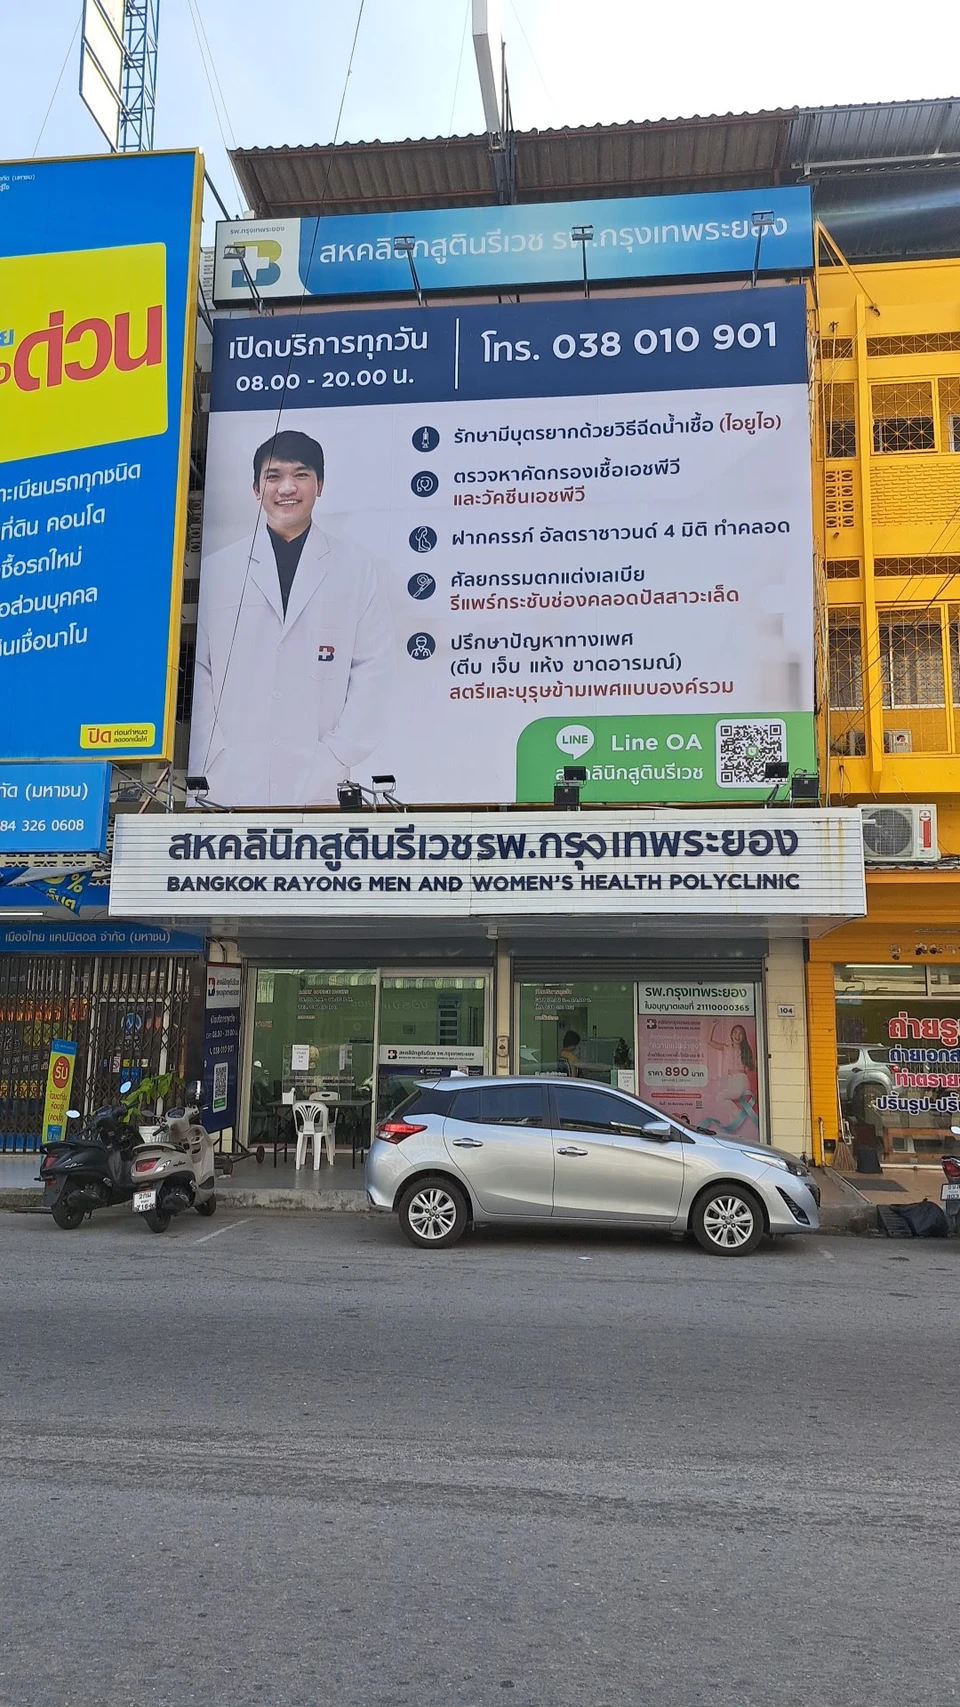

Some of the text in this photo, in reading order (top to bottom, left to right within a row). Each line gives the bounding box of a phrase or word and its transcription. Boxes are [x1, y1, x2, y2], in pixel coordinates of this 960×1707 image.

[14, 304, 163, 392] ด่วน
[229, 326, 429, 360] เปิดบริการทุกวัน
[481, 321, 777, 363] โทร. 038 010 901
[236, 373, 300, 392] 08.00
[322, 369, 387, 389] 20.00
[393, 367, 414, 385] น.
[454, 411, 782, 445] รักษามีบุตรยากด้วยวิธีฉีดน้ำเชื้อ (ไอยูไอ)
[454, 457, 681, 484] ตรวจหาคัดกรองเชื้อเอชพีวี
[453, 485, 586, 507] และวัคซีนเอชพีวี
[47, 503, 106, 532] คอนโด
[452, 518, 790, 546] ฝากครรภ์ อัลตราซาวนด์ 4 มิติ ทำคลอด
[450, 565, 645, 588] ศัลยกรรมตกแต่งเลเบีย
[450, 587, 739, 612] รีแพร์กระชับช่องคลอดปัสสาวะเล็ด
[451, 631, 634, 651] ปรึกษาปัญหาทางเพศ
[450, 652, 682, 676] (ตีบ เจ็บ แห้ง ขาดอารมณ์)
[450, 677, 734, 703] สตรีและบุรุษข้ามเพศแบบองค์รวม
[87, 728, 112, 744] ปิด
[562, 735, 589, 745] LINE
[611, 733, 702, 751] Line OA
[555, 762, 704, 785] สลินิกสูตินรีเวช
[25, 782, 89, 801] (มหาชน)
[0, 819, 84, 831] 84 326 0608
[167, 876, 268, 892] BANGKOK
[273, 876, 362, 892] RAYONG
[369, 876, 411, 892] MEN
[418, 876, 463, 892] AND
[580, 874, 662, 890] HEALTH
[669, 873, 800, 890] POLYCLINIC
[5, 930, 171, 944] เมืองไทย แคปปิตอล จำกัด (มหาชน)
[645, 986, 747, 1000] รพ.กรุงเทพระยอง
[696, 1004, 750, 1012] 21110000365
[780, 1007, 793, 1015] 104
[665, 1066, 689, 1077] 890
